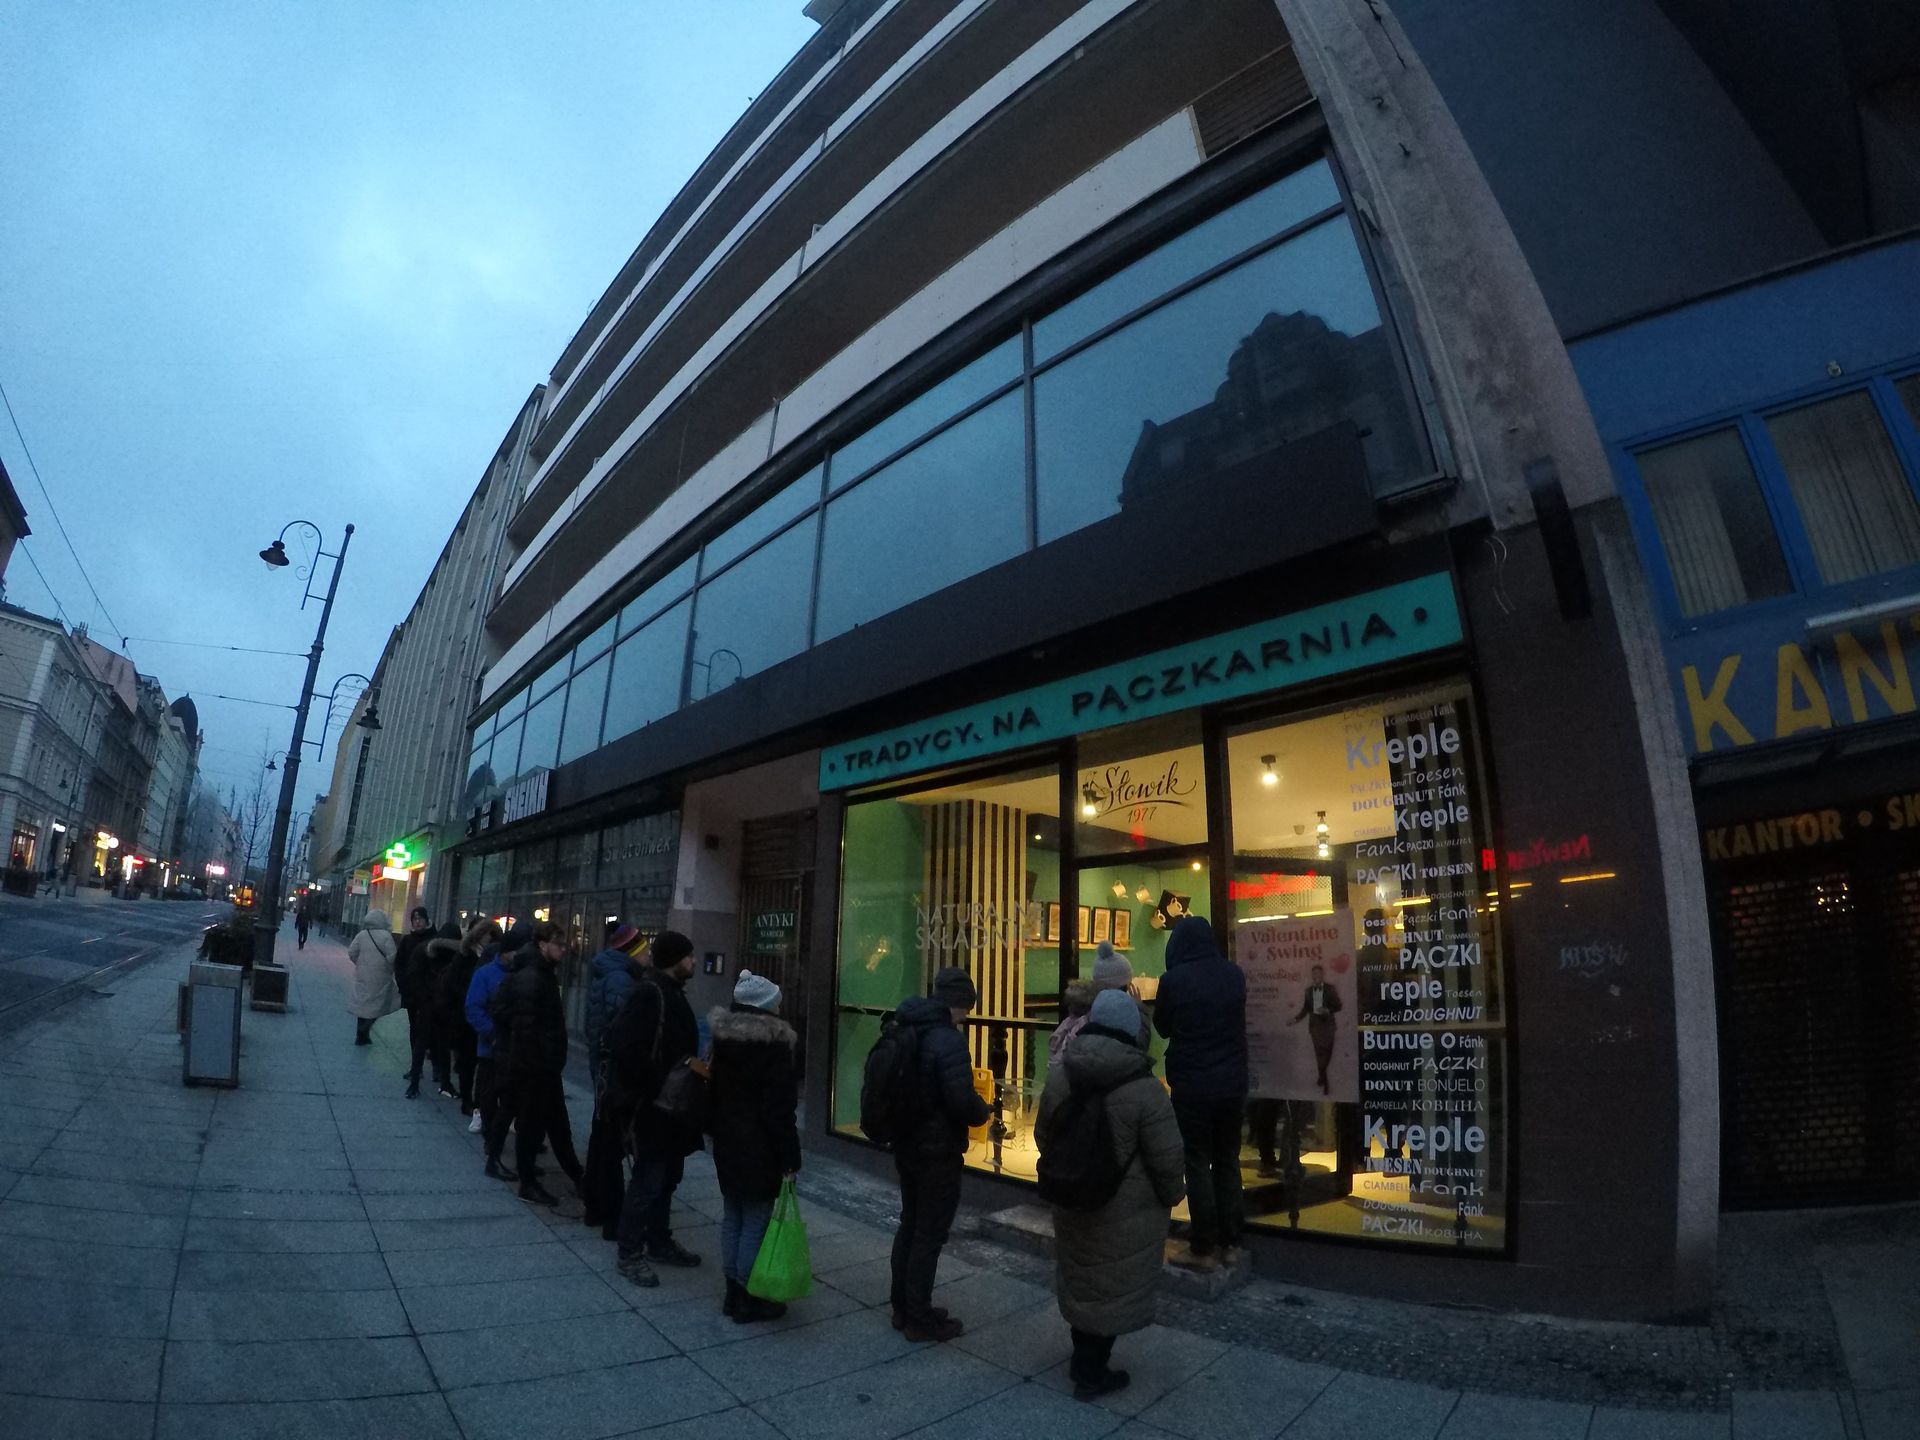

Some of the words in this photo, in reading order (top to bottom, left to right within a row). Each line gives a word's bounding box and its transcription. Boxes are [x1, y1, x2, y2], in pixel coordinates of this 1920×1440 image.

[1071, 612, 1396, 718] PĄCZKARNIA
[1682, 614, 1920, 753] KAN
[1346, 722, 1460, 770] Kreple
[1105, 760, 1197, 811] Słowik
[1403, 766, 1465, 786] Toesen
[1437, 783, 1467, 800] Fánk
[1128, 806, 1158, 823] 1977
[1394, 800, 1470, 833] Kreple
[1705, 807, 1844, 861] KANTOR
[1355, 837, 1406, 859] Fank
[1420, 862, 1474, 880] TOESEN
[755, 912, 794, 928] ANTYKI
[1439, 903, 1479, 920] Fank
[1250, 926, 1339, 944] Valentine
[1266, 943, 1323, 962] Swing
[1399, 943, 1481, 974] PĄCZKI
[1363, 1011, 1401, 1025] Pączki
[1402, 1006, 1484, 1022] DOUGHNUT
[1459, 1034, 1485, 1049] Fánk
[1363, 1061, 1411, 1071] DOUGHNUT
[1412, 1055, 1486, 1074] PĄCZKI
[1364, 1079, 1414, 1092] DONUT
[1417, 1078, 1486, 1093] BONUELO
[1363, 1100, 1408, 1111] CIAMBELLA
[1411, 1099, 1485, 1113] KOBLIHA
[1363, 1114, 1486, 1161] Kreple
[1424, 1166, 1486, 1178] DOUGHNUT
[1362, 1180, 1417, 1194] CIAMBELLA
[1418, 1179, 1485, 1198] Fank
[1457, 1201, 1485, 1217] Fánk
[1360, 1214, 1425, 1236] PĄCZKI
[1425, 1226, 1484, 1241] KOBLIHA
